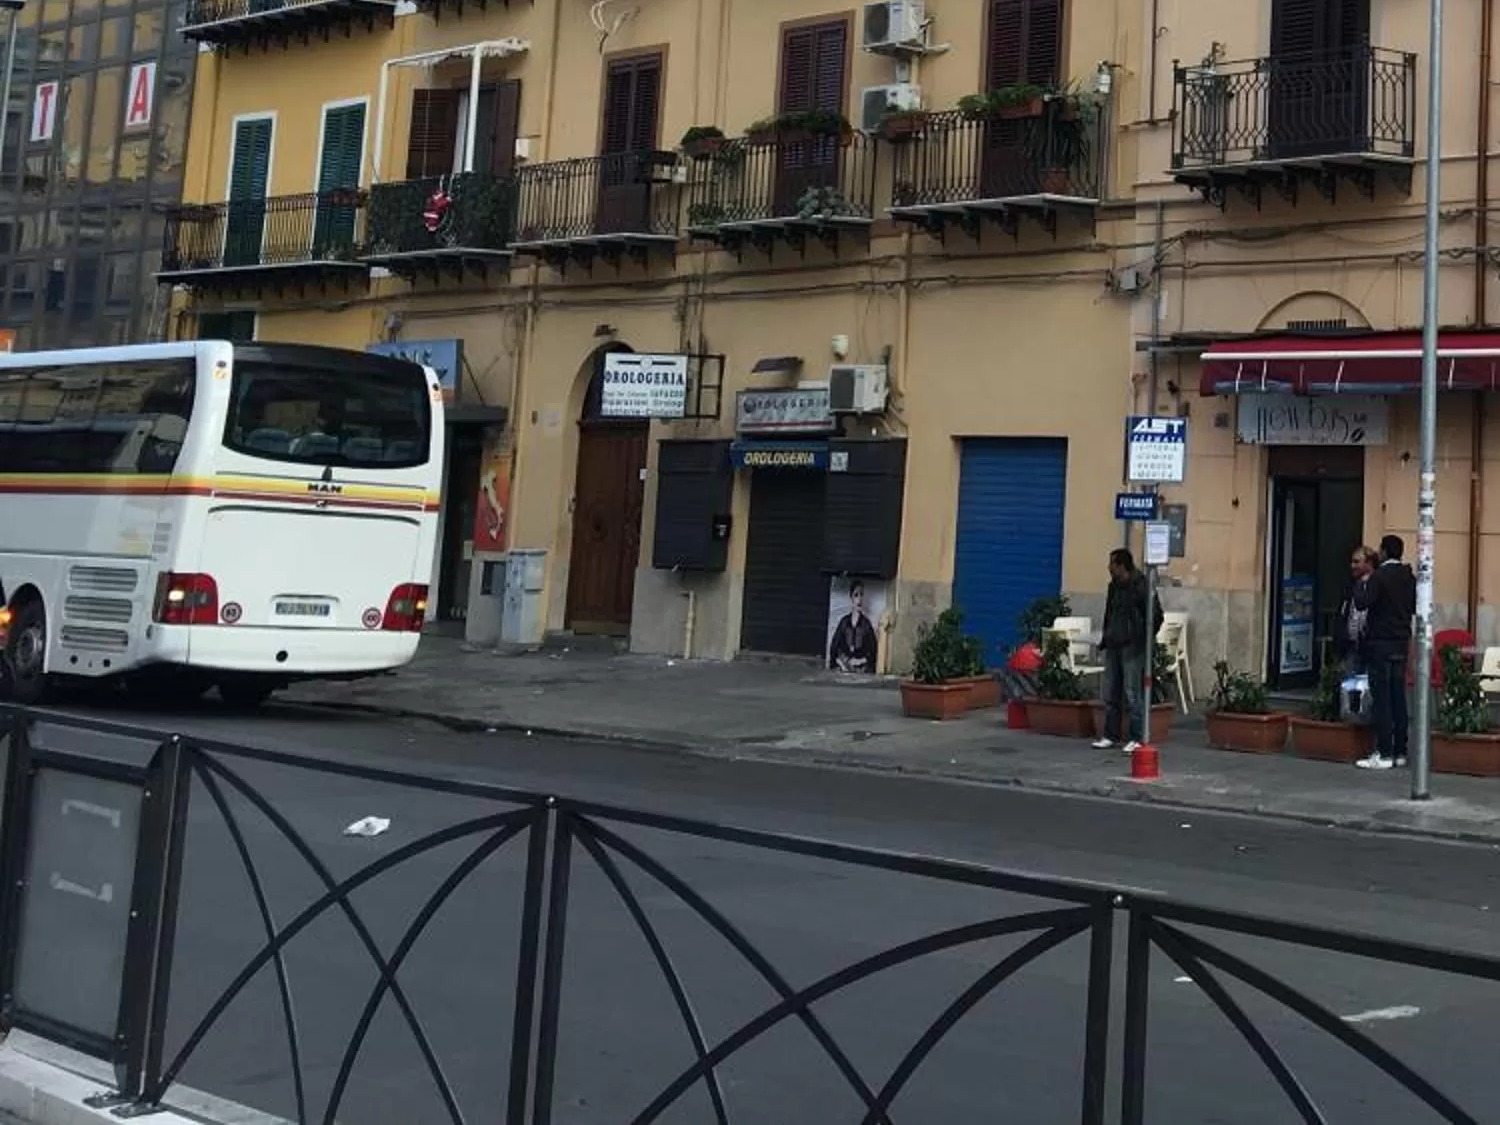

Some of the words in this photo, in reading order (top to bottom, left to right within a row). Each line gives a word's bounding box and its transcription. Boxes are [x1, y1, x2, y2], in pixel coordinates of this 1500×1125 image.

[604, 370, 684, 386] OROLOGERIA
[1133, 418, 1185, 434] AST
[743, 451, 815, 465] OROLOGERIA
[307, 483, 342, 493] MAN
